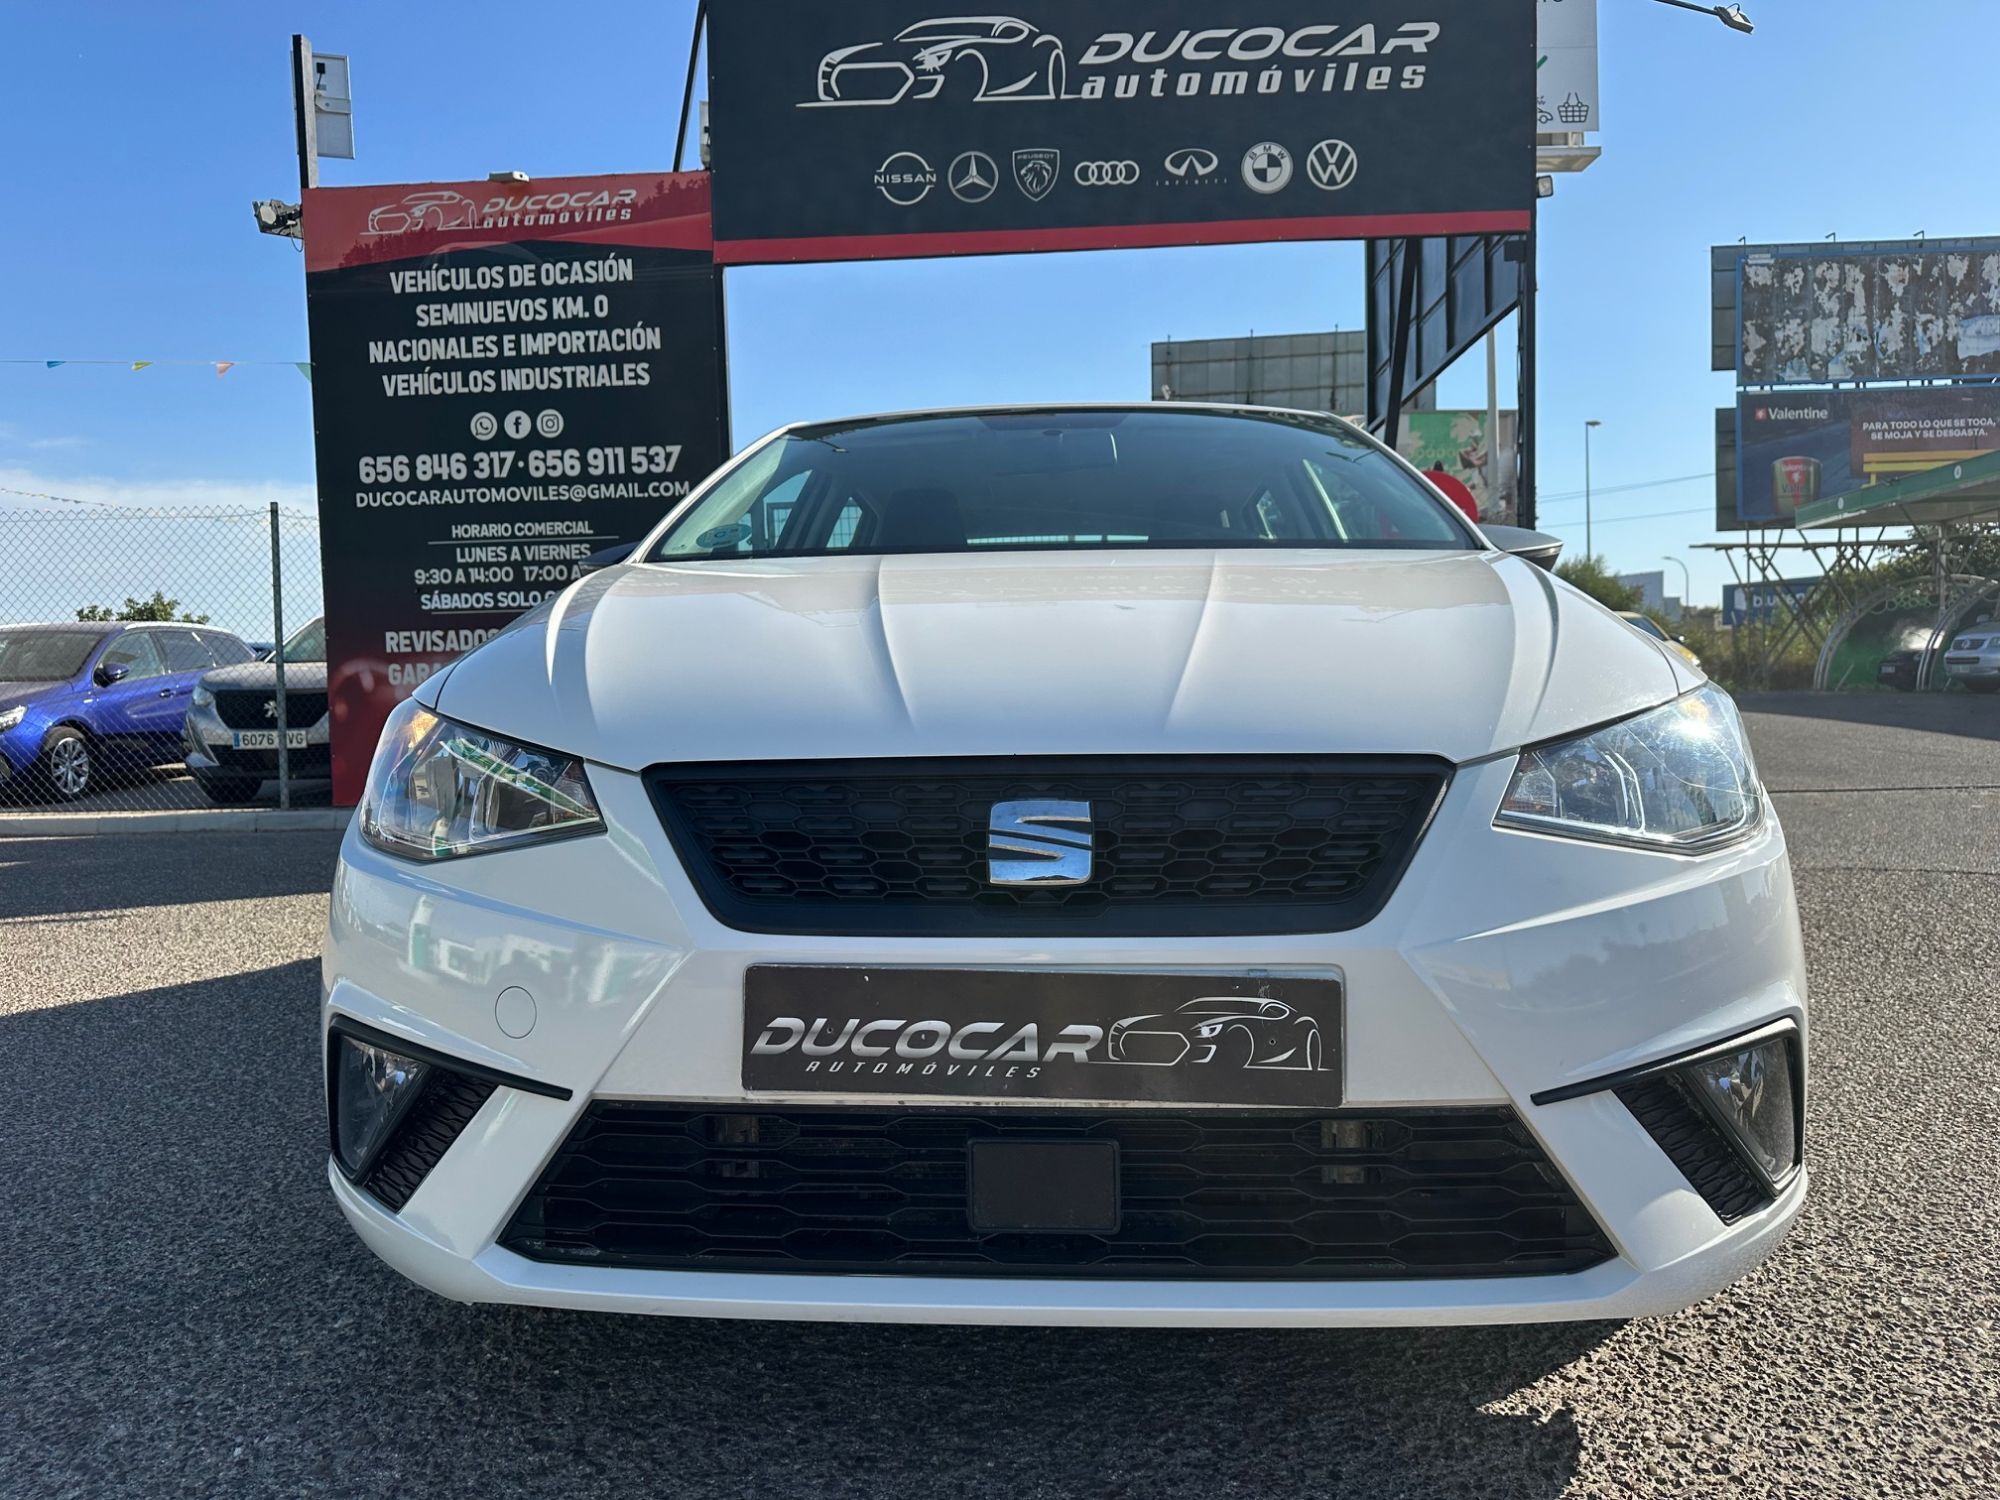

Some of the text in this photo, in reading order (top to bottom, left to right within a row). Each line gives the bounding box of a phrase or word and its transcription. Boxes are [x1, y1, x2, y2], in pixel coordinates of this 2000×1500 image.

[1078, 21, 1441, 65] DUCOCAR
[1081, 60, 1427, 98] automóviles
[874, 172, 937, 184] NISSAN
[482, 188, 638, 214] DUCOCAR
[483, 207, 632, 229] automóviles
[390, 253, 633, 295] VEHÍCULOS DE OCASIÓN
[416, 298, 548, 328] SEMINUEVOS
[552, 296, 590, 320] KM.
[368, 322, 661, 364] NACIONALES E IMPORTACIÓN
[382, 362, 651, 397] VEHÍCULOS INDUSTRIALES
[1768, 407, 1829, 420] Valentine
[1862, 417, 1996, 431] PARA TODO LO QUE SE TOCA,
[1871, 428, 1988, 440] SE MOJA Y SE DESGASTA.
[358, 456, 410, 484] 656
[415, 453, 467, 481] 846
[587, 447, 624, 476] 911
[630, 445, 683, 473] 537
[355, 481, 690, 508] DUCOCARAUTOMOVILES@GMAIL.COM
[451, 520, 594, 539] HORARIO COMERCIAL
[456, 544, 591, 563] LUNES A VIERNES
[414, 564, 582, 585] 9:30 A 14:00 17:00 A
[421, 590, 494, 610] SÁBADOS
[497, 591, 541, 608] SOLO
[242, 733, 304, 745] 6076 VG
[750, 1016, 1104, 1064] DUCOCAR
[805, 1058, 1043, 1079] AUTOMÓVILES
